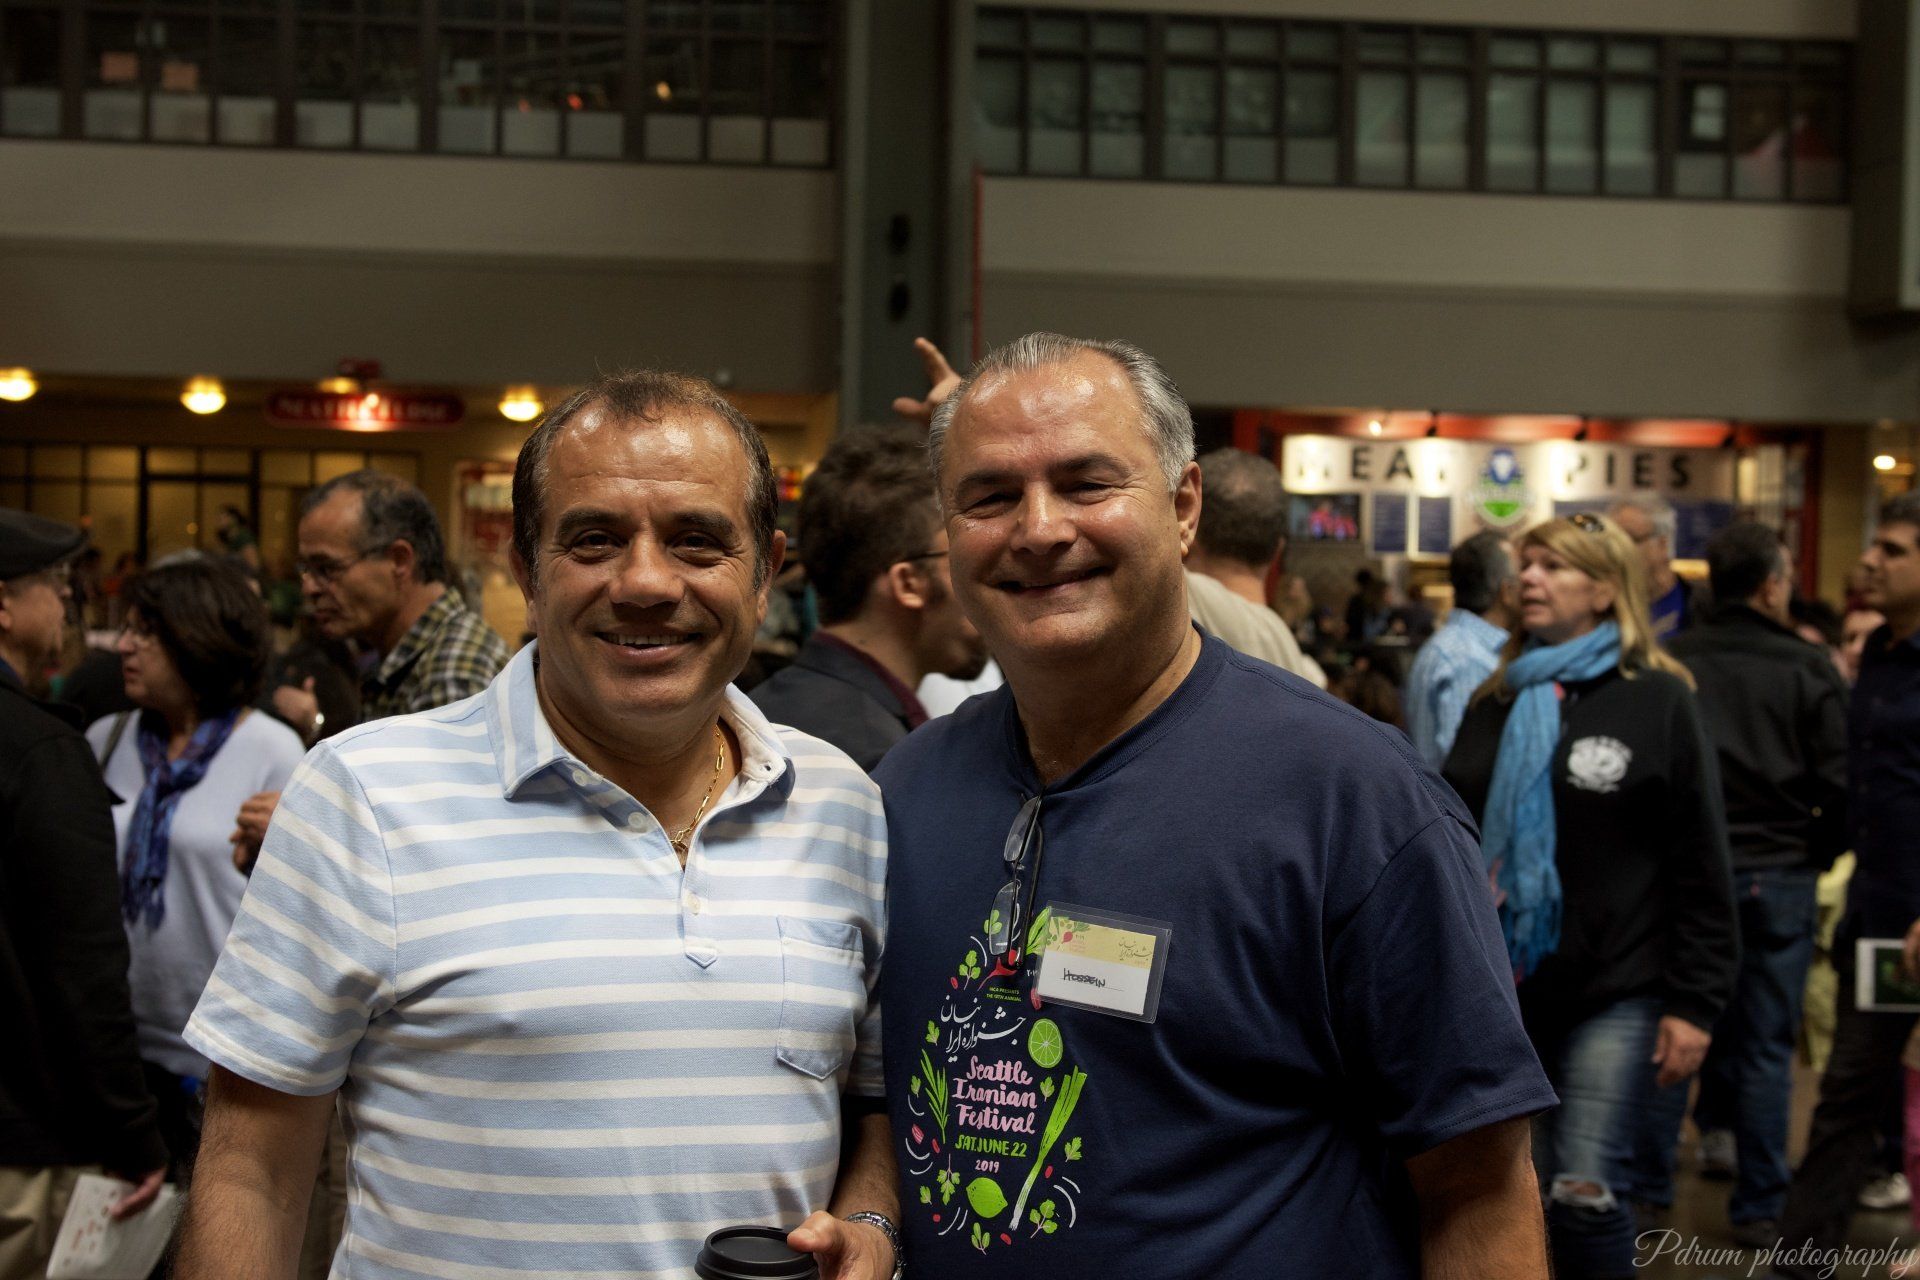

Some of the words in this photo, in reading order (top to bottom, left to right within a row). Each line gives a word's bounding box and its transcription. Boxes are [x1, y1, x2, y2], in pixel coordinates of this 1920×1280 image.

[966, 1055, 1033, 1085] Seattle
[952, 1078, 1037, 1109] Iranian
[956, 1104, 1036, 1135] Festival
[1010, 1142, 1028, 1158] 22
[975, 1159, 1000, 1174] 2019
